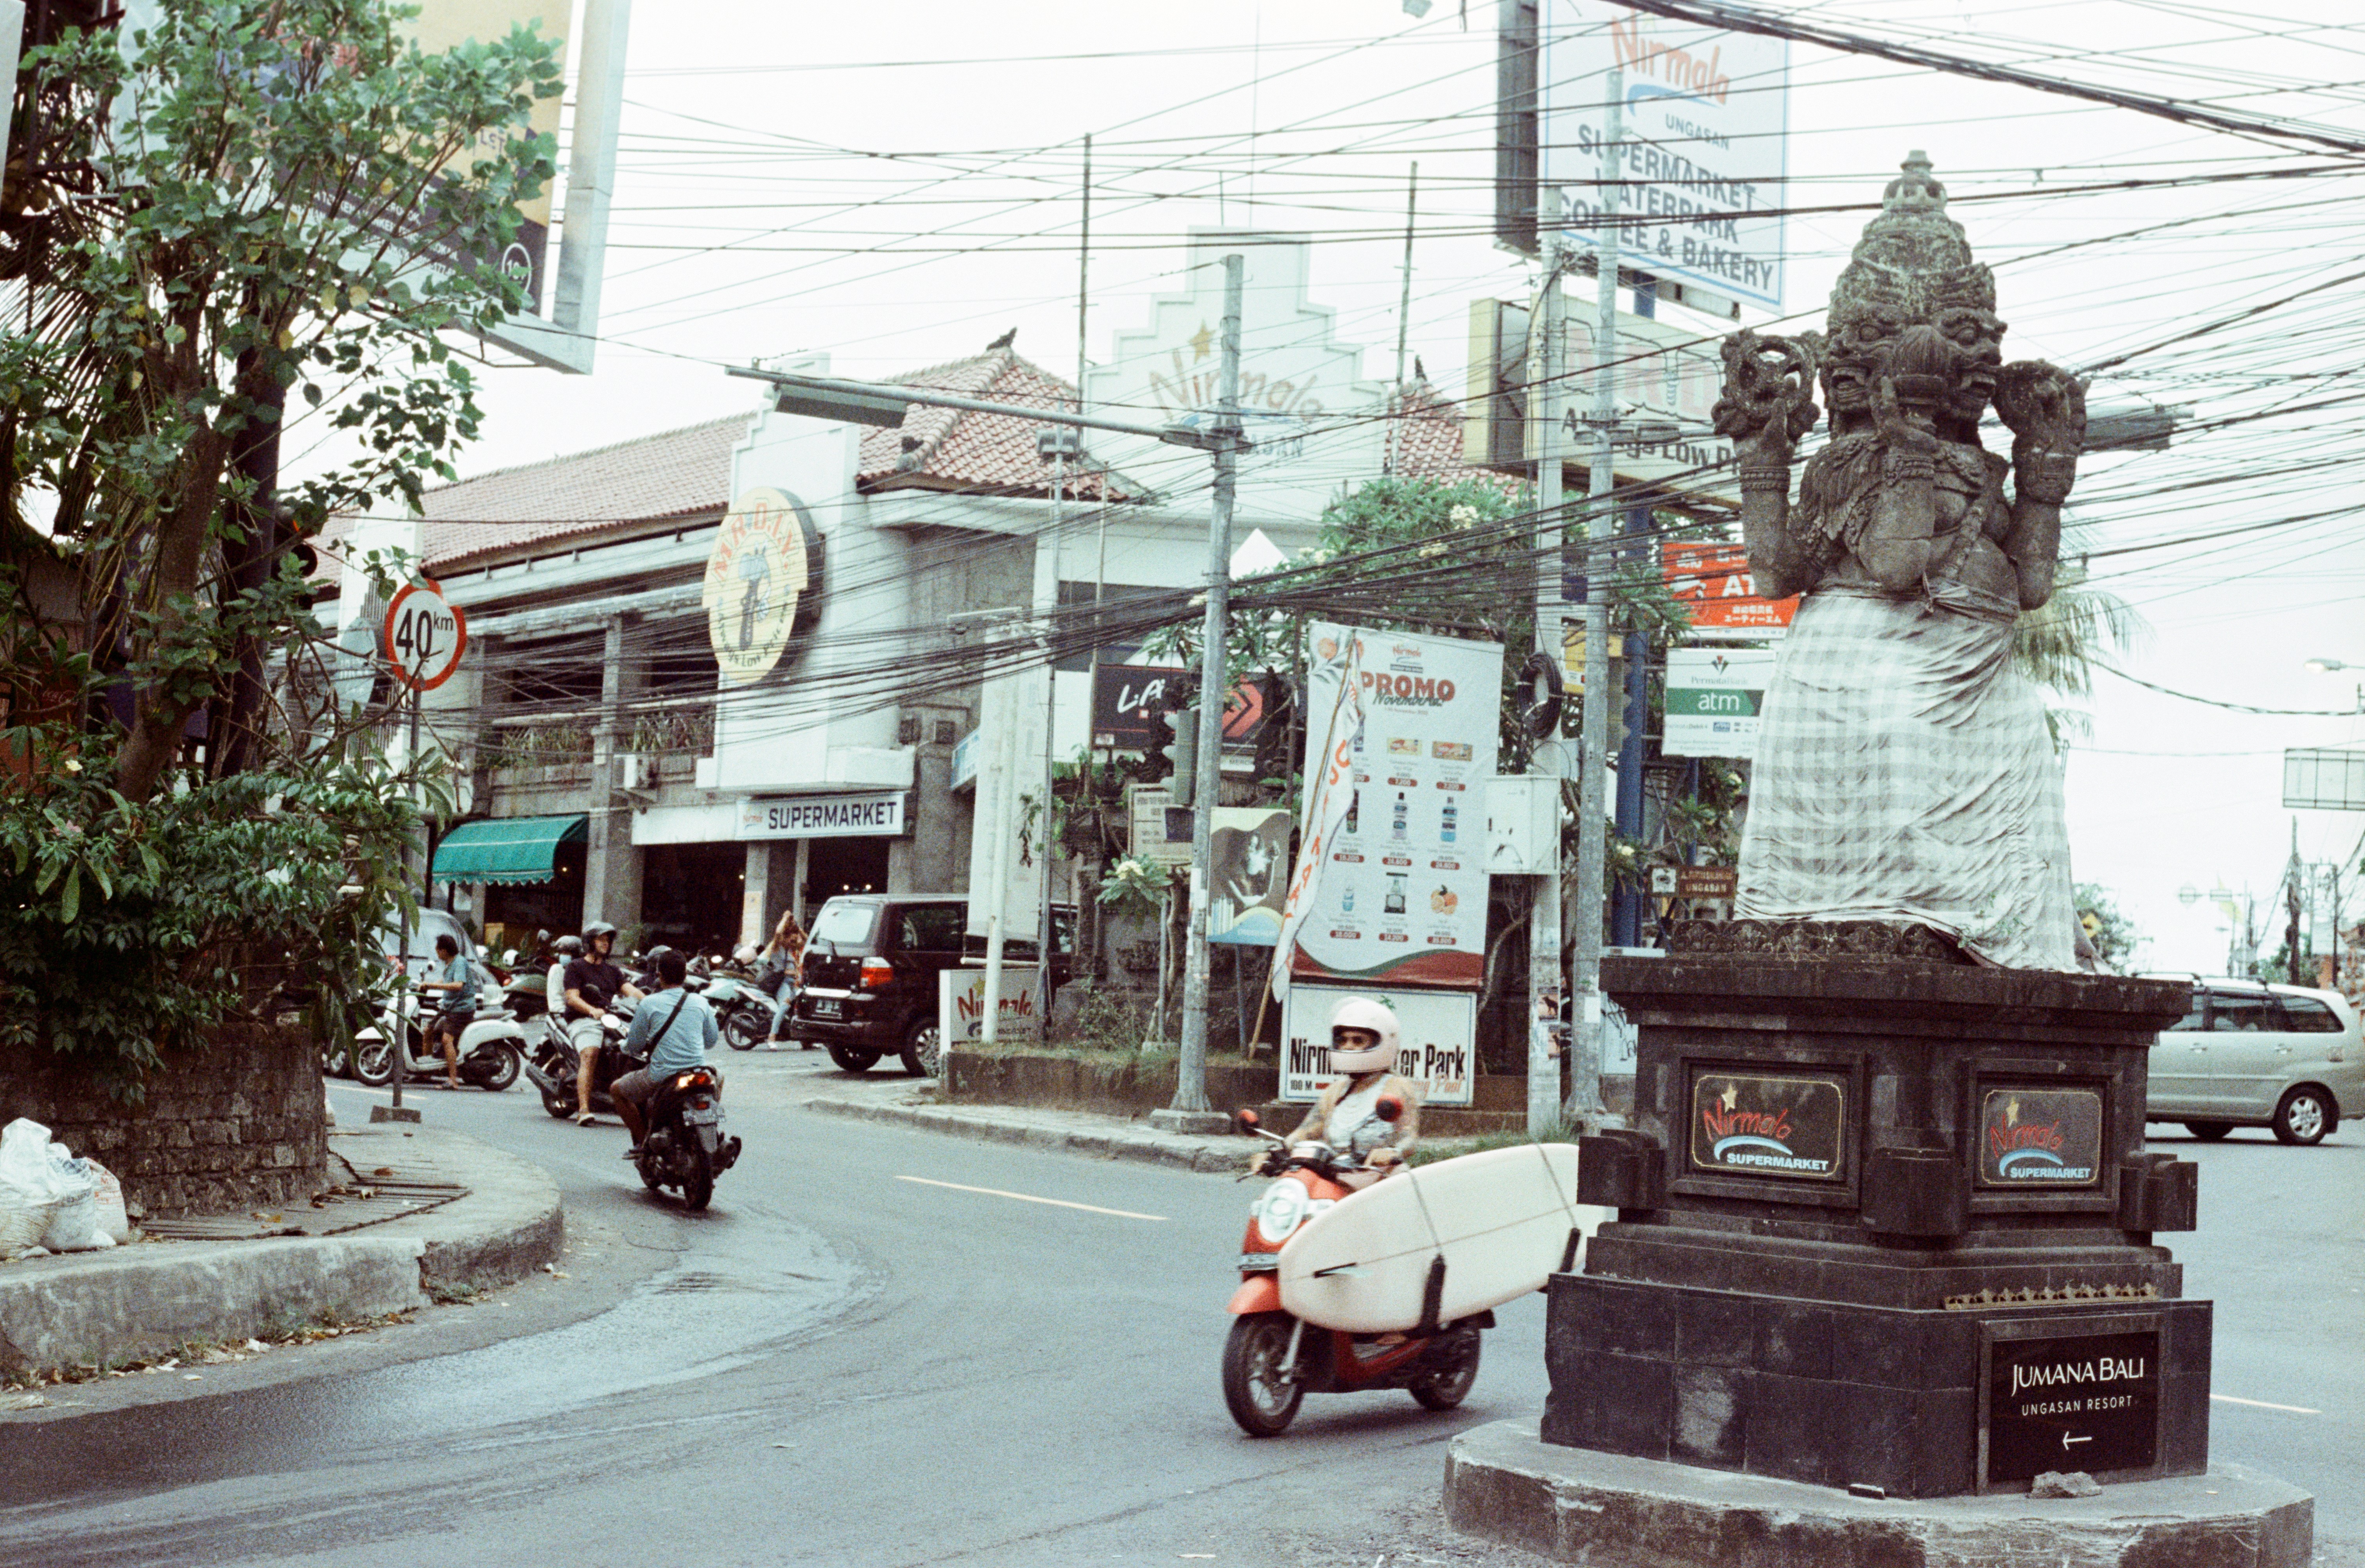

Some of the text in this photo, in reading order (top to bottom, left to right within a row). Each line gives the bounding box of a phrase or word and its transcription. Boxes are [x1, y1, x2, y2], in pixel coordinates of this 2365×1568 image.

[1611, 8, 1730, 105] Nirmala
[1665, 113, 1730, 151] UNGASAN
[1595, 166, 1739, 244] ATERPARK
[1683, 236, 1773, 290] BAKERY
[1721, 575, 1756, 597] AT
[395, 608, 454, 658] 40 km
[1360, 671, 1455, 702] PROMO
[1698, 692, 1739, 711] atm
[768, 801, 897, 830] SUPERMARKET
[1290, 1038, 1331, 1074] Nirm
[1425, 1044, 1466, 1081] Park
[1290, 1080, 1312, 1090] 100 M
[1703, 1098, 1793, 1143] Nirmala
[1990, 1115, 2062, 1159] Nirmala
[1726, 1152, 1828, 1172] SUPERMARKET
[2010, 1166, 2090, 1179] SUPERMARKET
[2011, 1357, 2144, 1397] JUMANA BALI
[2021, 1395, 2132, 1416] UNGASAN RESORT
